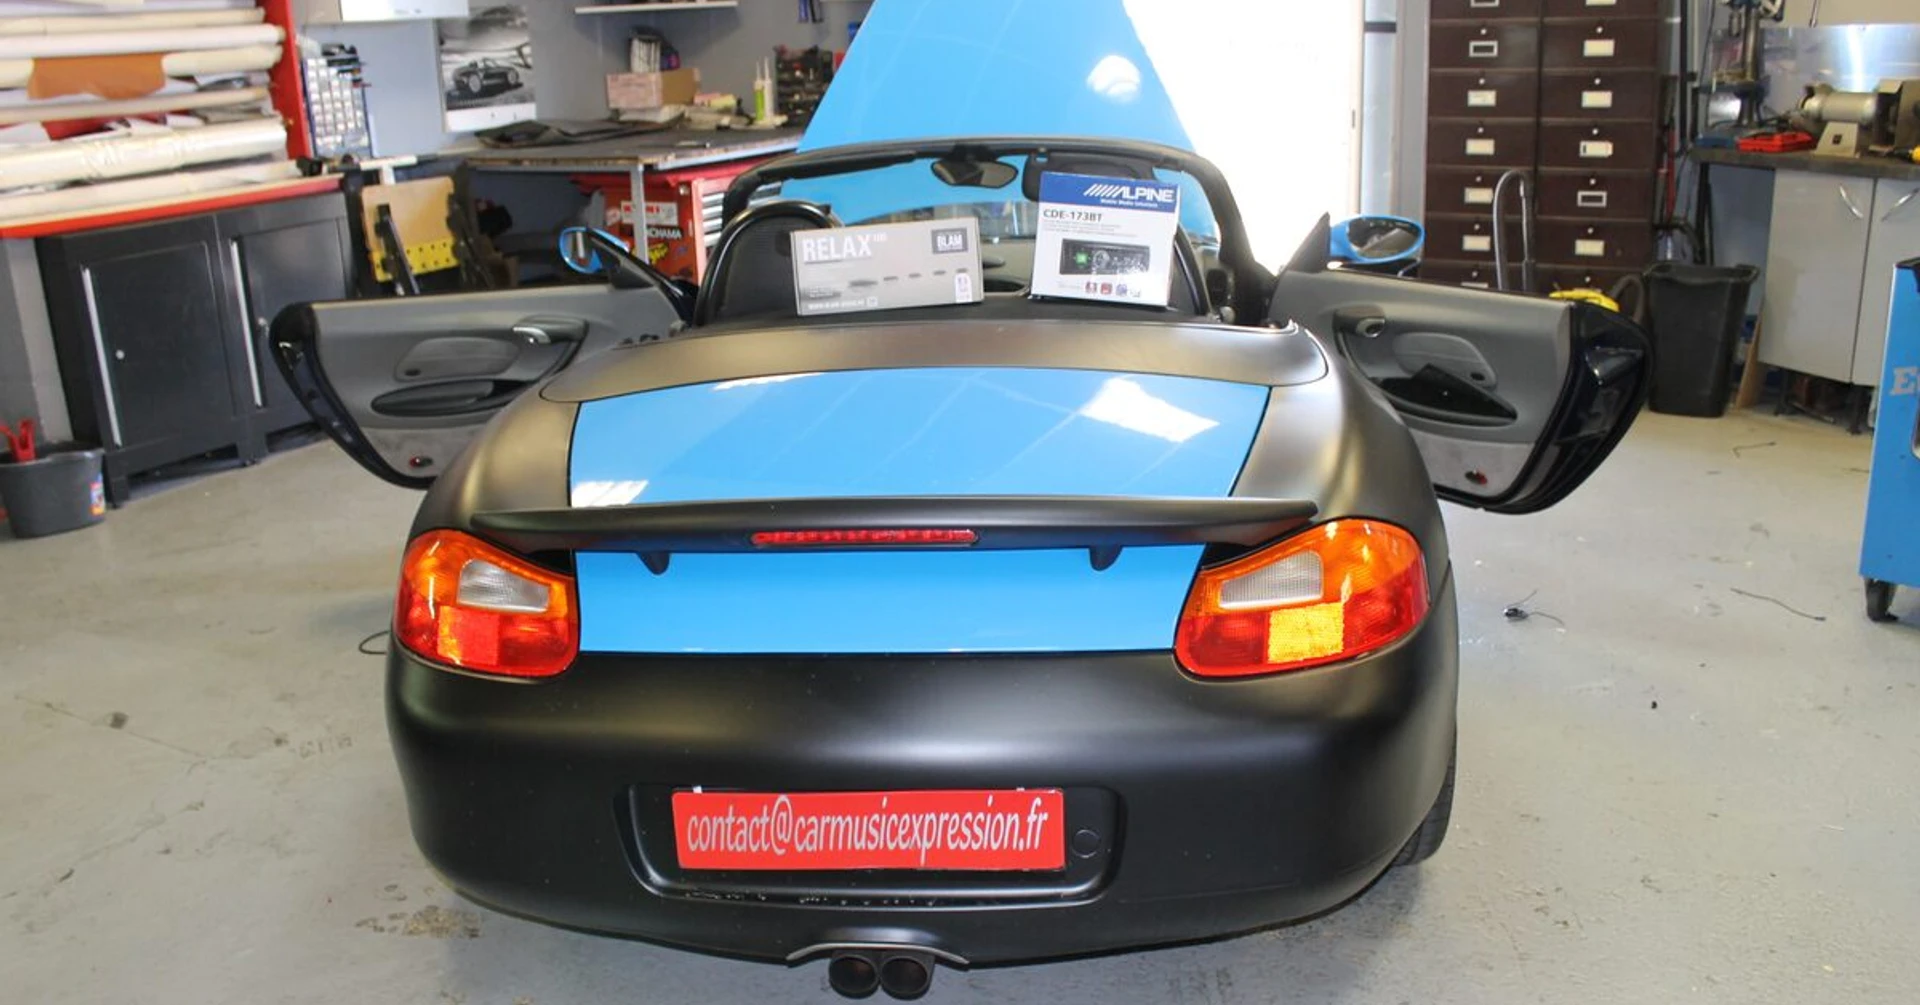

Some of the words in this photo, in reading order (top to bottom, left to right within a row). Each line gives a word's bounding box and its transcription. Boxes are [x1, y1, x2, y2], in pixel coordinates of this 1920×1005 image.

[1111, 184, 1174, 203] ALPINE
[1043, 208, 1102, 222] CDE-173BT
[802, 234, 871, 262] RELAX
[936, 234, 963, 249] BLAM
[687, 795, 1048, 865] contact@carmusicexpression.fr
